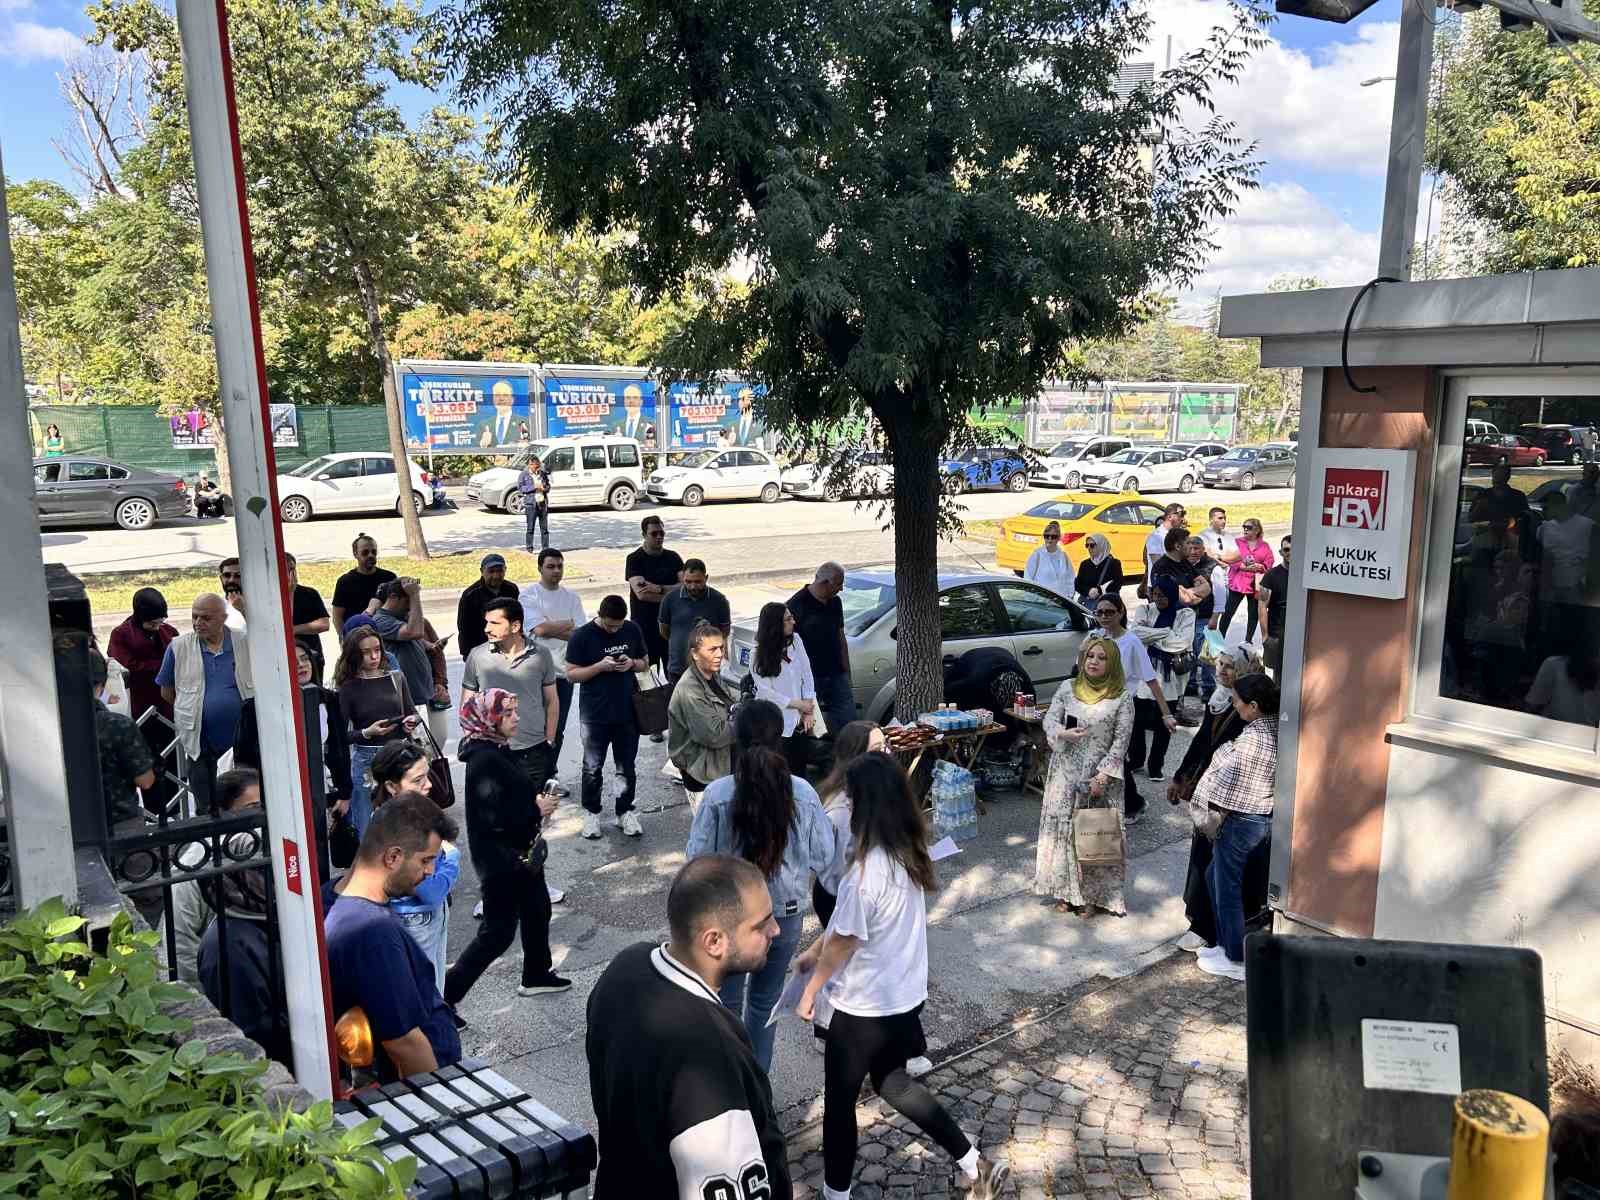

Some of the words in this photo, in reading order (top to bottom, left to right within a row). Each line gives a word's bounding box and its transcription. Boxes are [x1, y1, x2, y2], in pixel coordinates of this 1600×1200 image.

[1327, 483, 1379, 497] ankara
[1325, 546, 1377, 562] HUKUK
[1311, 561, 1391, 580] FAKÜLTESİ
[288, 855, 298, 878] Nice
